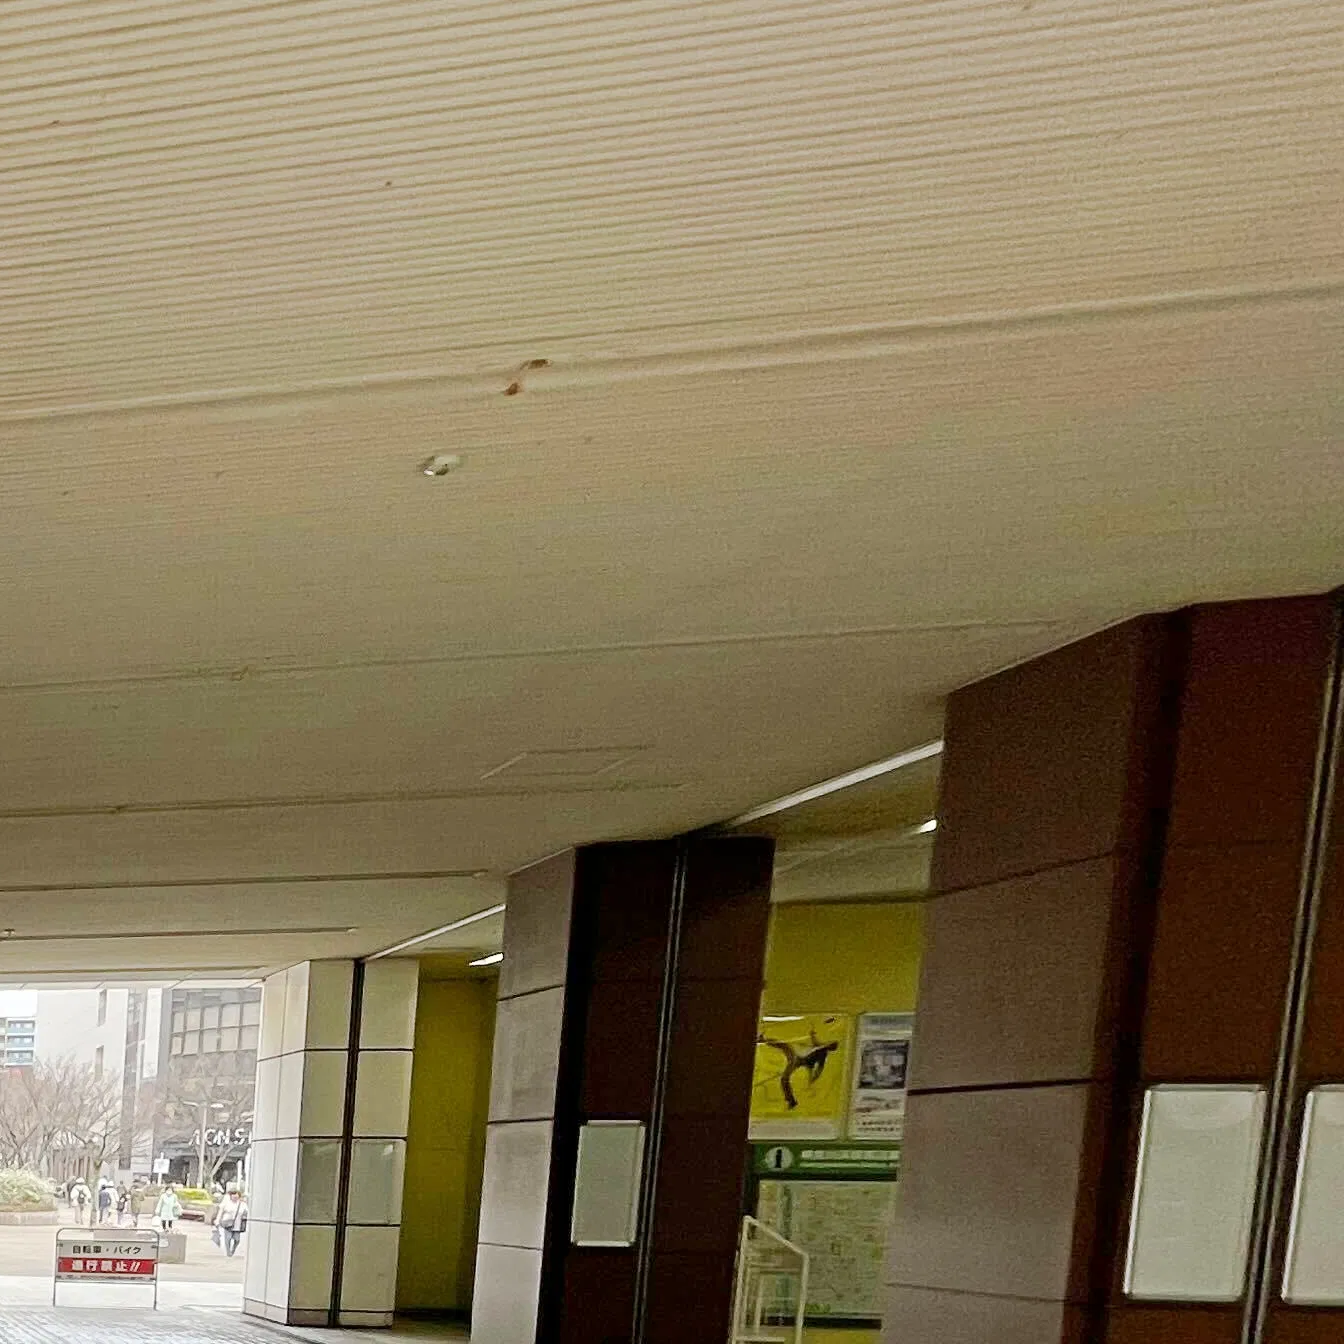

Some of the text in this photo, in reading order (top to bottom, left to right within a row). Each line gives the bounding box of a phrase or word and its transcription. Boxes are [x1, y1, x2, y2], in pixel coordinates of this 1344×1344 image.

[73, 1246, 142, 1255] 自転車・バイク
